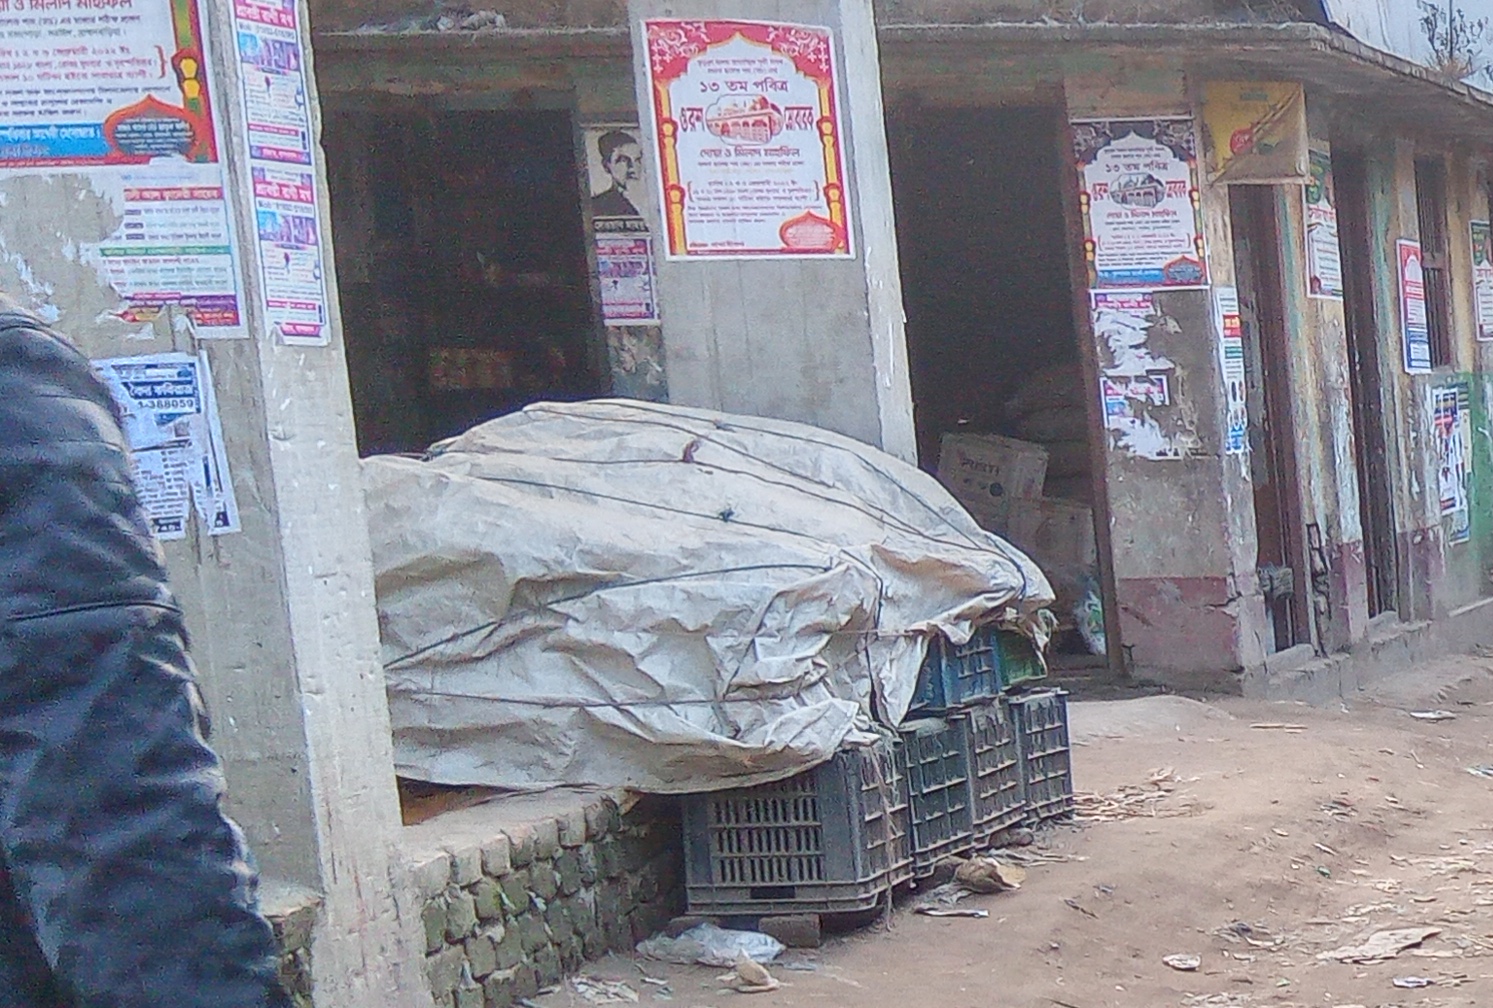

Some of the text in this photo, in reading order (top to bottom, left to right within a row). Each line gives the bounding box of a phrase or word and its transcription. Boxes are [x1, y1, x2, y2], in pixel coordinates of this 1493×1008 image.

[700, 77, 788, 93] ১৩ তম পবিত্র
